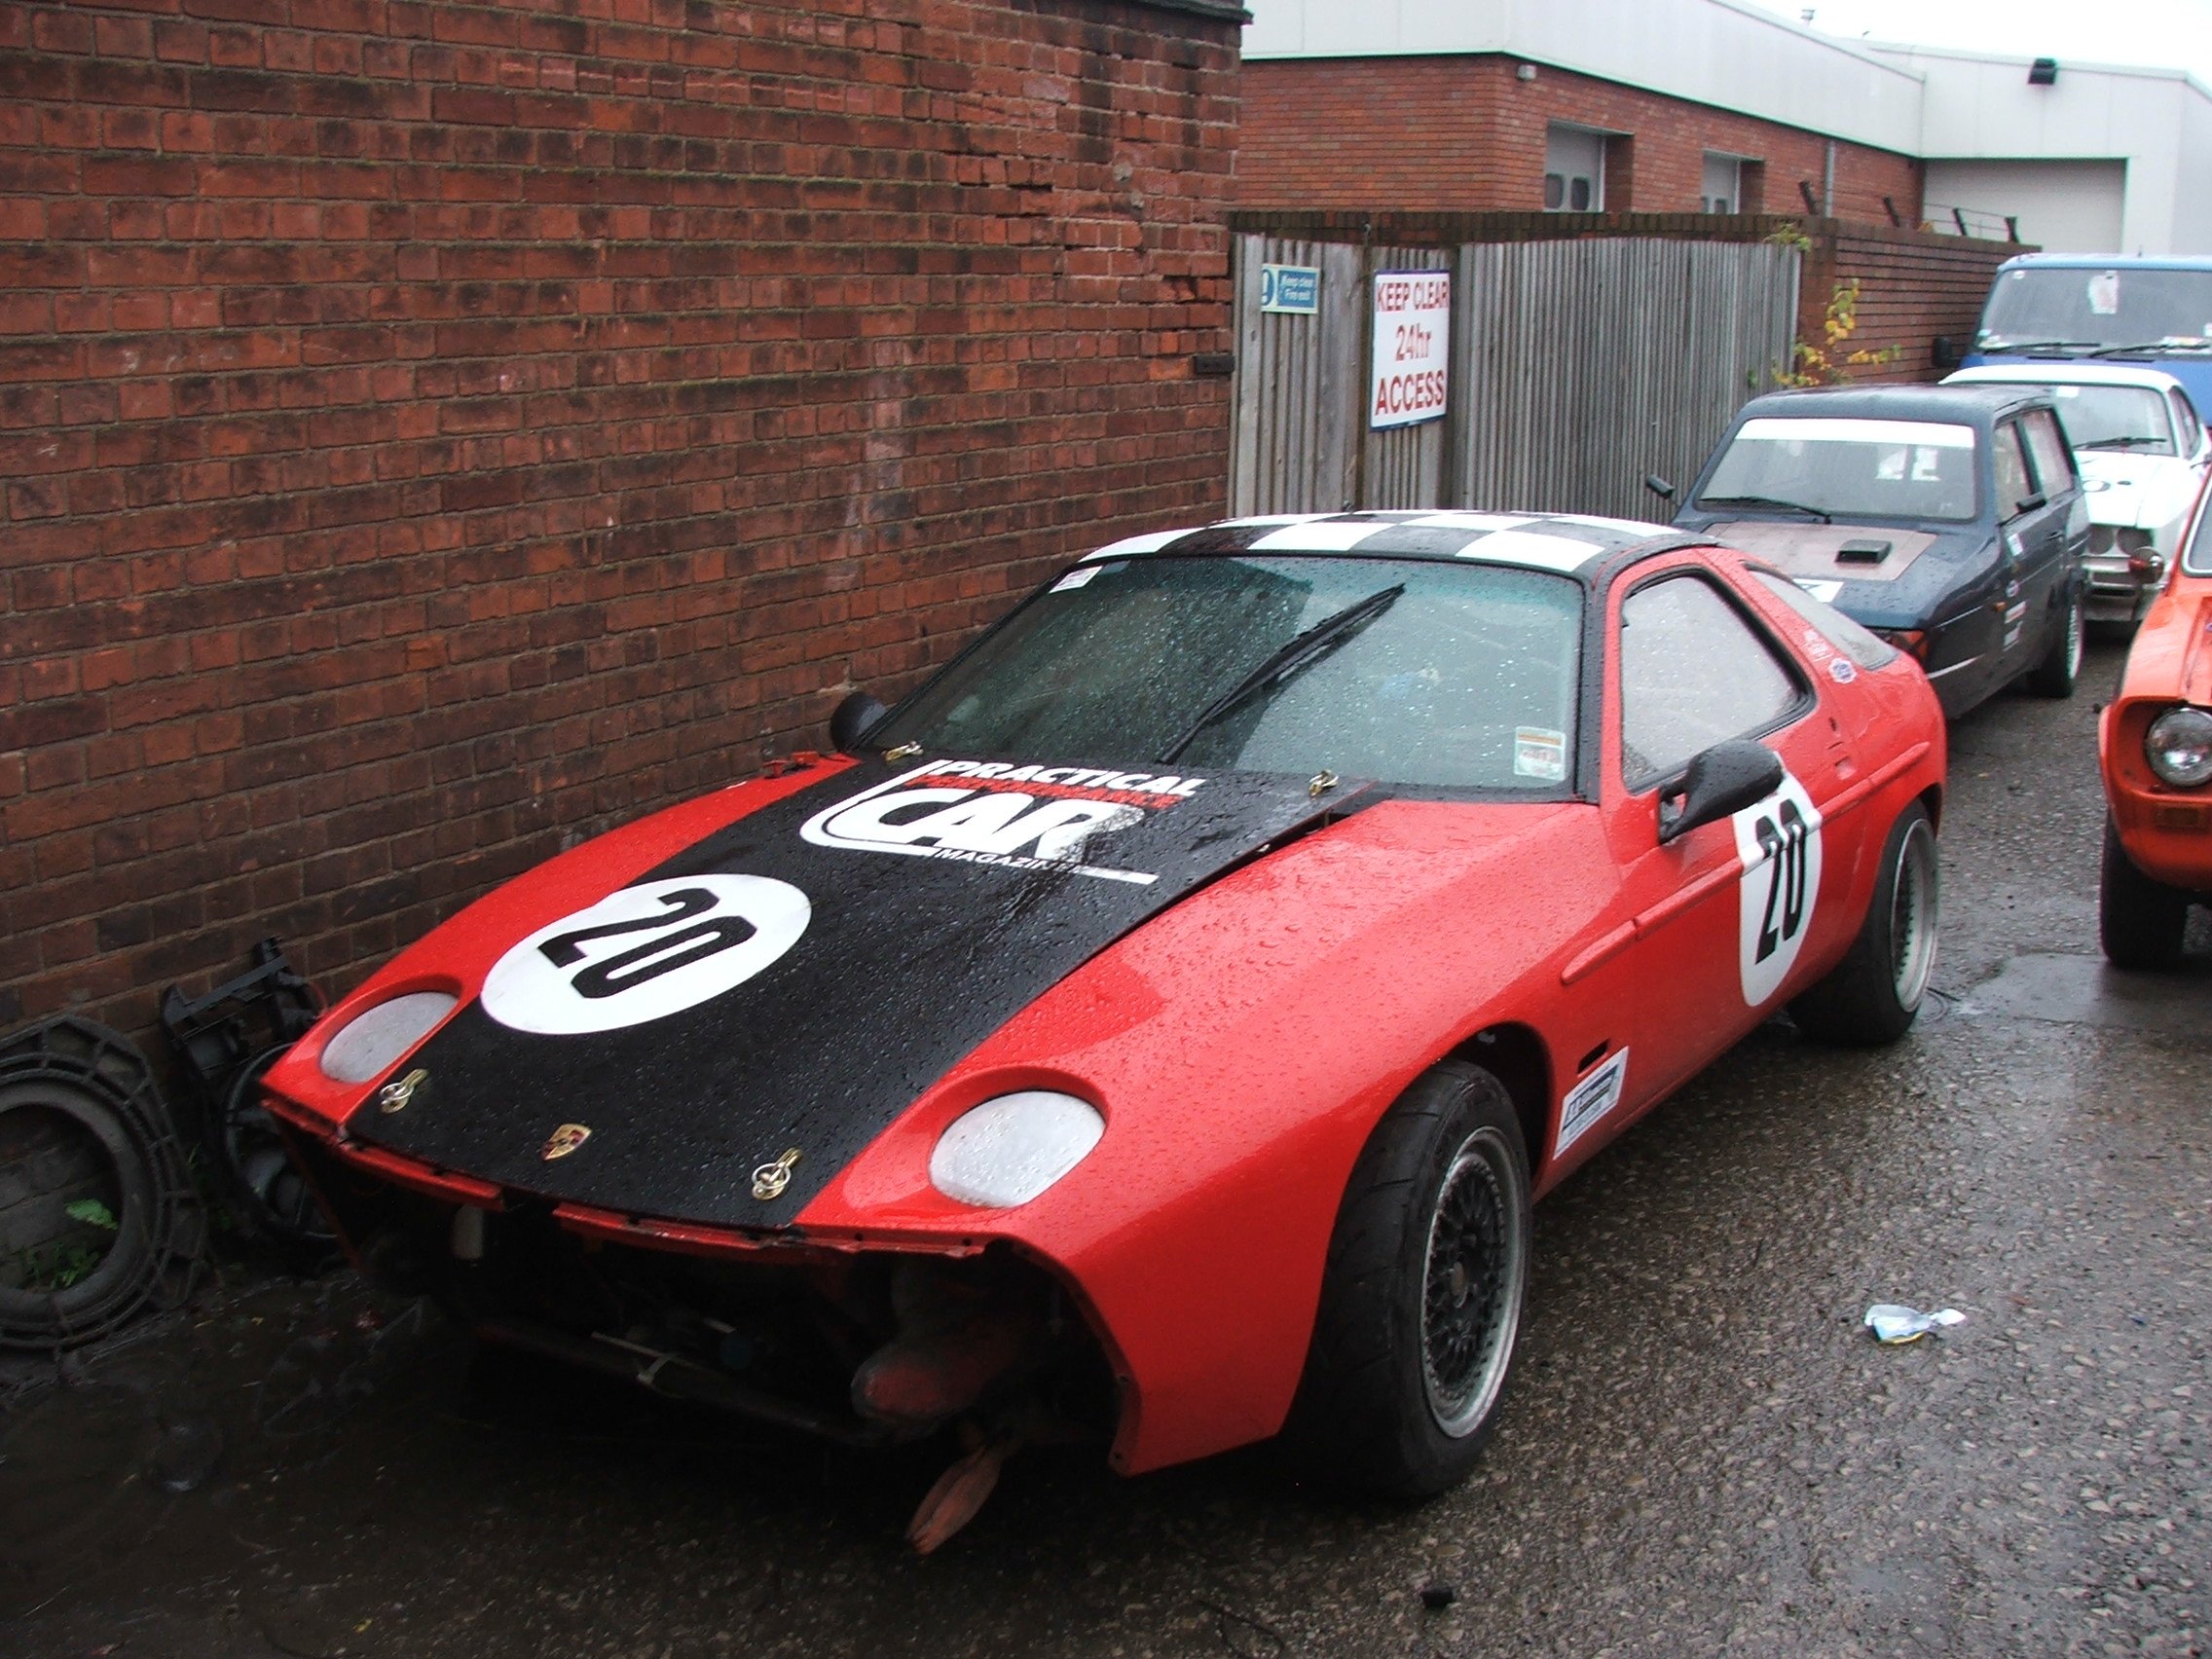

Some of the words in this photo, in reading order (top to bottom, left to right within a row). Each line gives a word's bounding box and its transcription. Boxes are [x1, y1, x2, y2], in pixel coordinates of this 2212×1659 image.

[1377, 281, 1410, 311] KEEP
[1414, 280, 1449, 310] CLEAR
[1394, 322, 1431, 361] 24hr
[1375, 369, 1445, 416] ACCESS
[938, 759, 1206, 796] PRACTICAL
[825, 788, 1145, 864] CAR
[1755, 798, 1806, 965] 20
[537, 887, 757, 999] 20
